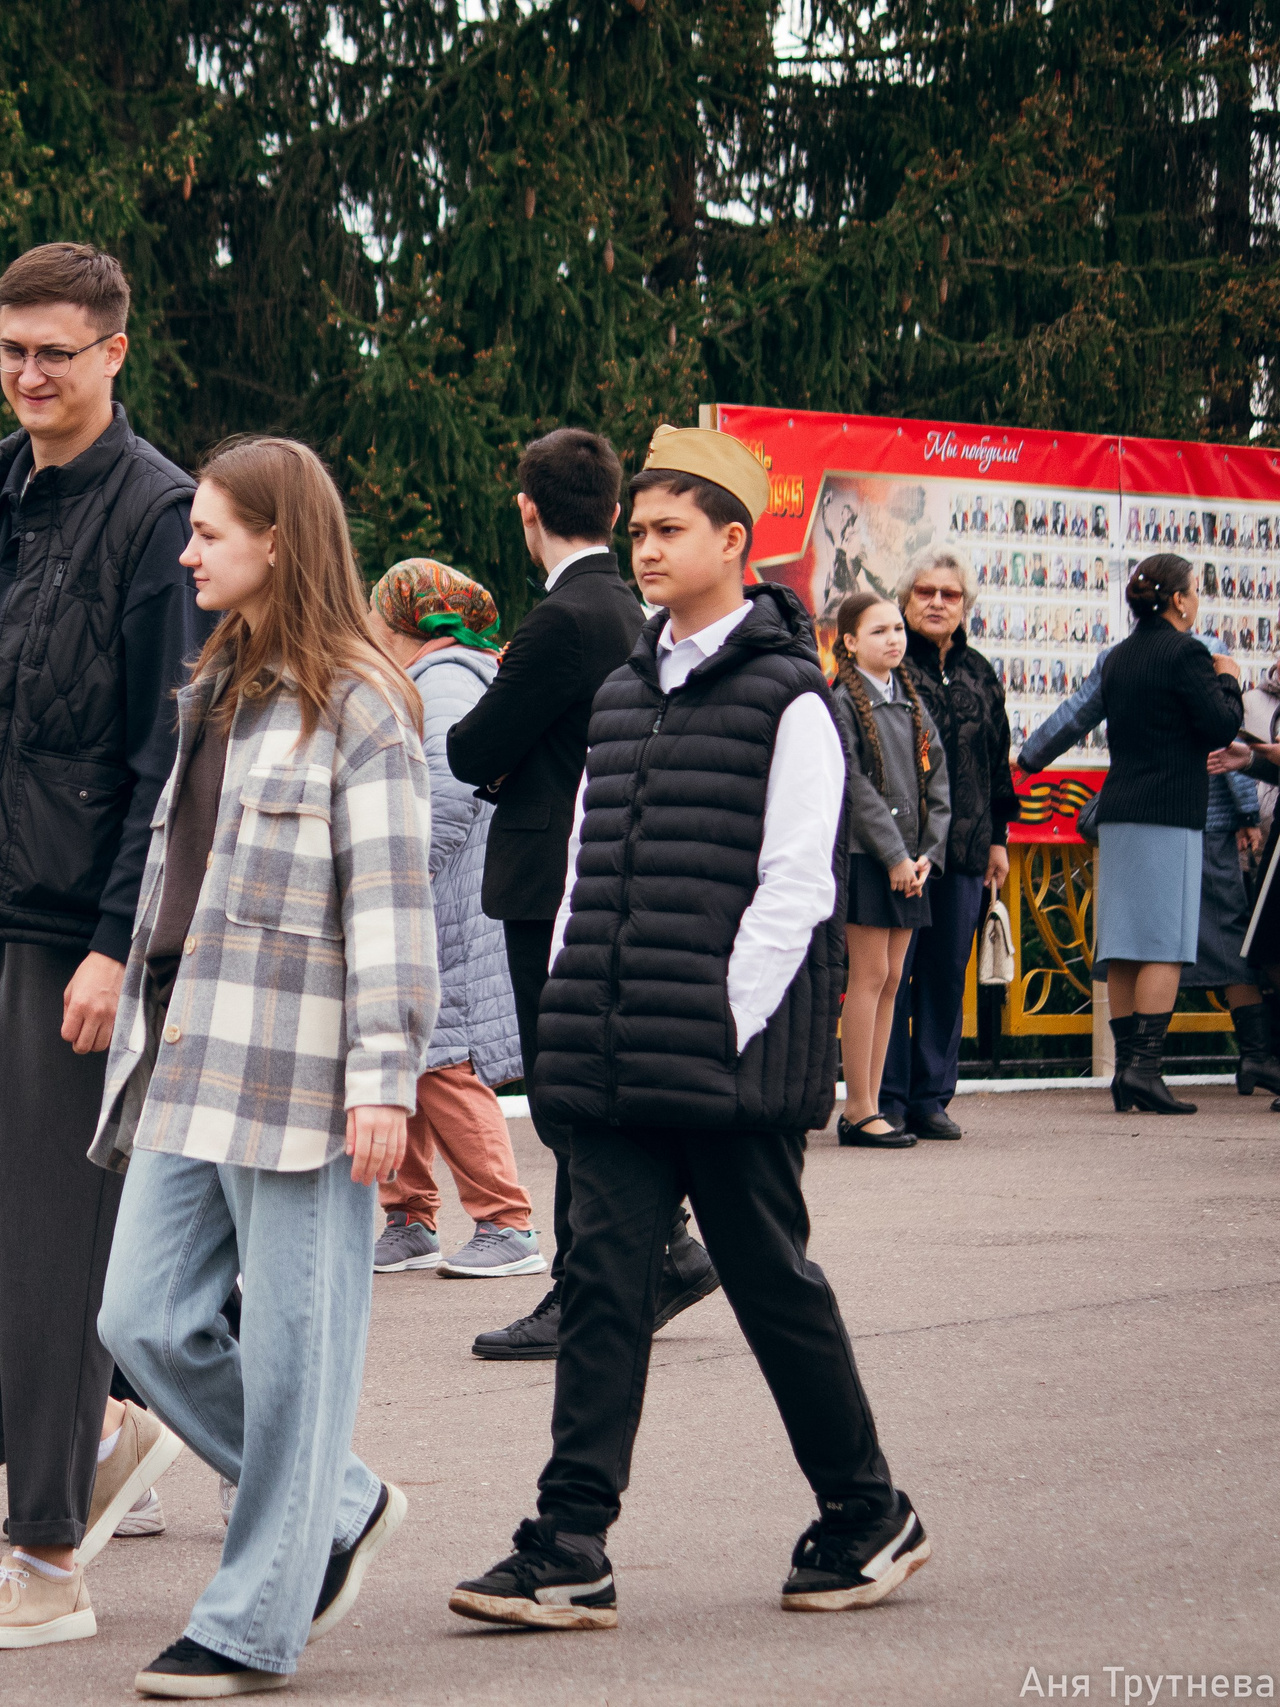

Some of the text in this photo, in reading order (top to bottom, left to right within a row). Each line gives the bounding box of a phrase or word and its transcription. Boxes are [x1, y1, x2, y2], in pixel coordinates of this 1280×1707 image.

[924, 430, 1024, 473] Мы победили!
[768, 474, 804, 518] 1945
